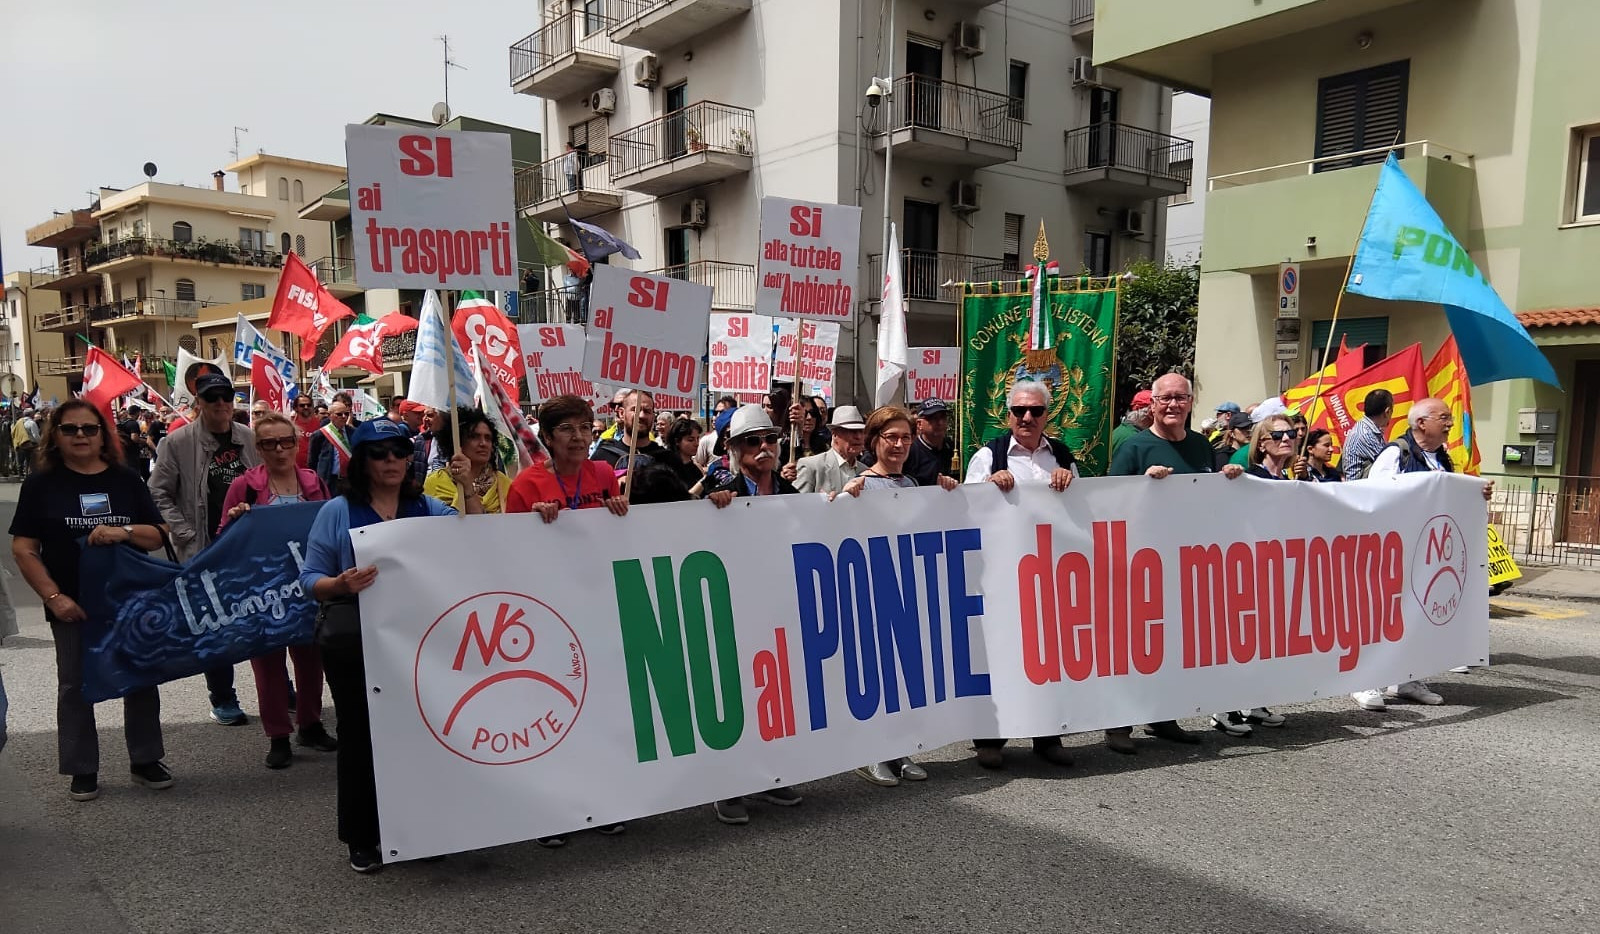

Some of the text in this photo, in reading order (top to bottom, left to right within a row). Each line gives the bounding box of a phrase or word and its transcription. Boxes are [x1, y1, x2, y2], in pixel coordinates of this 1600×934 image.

[400, 135, 452, 177] SI
[358, 183, 382, 211] ai
[366, 218, 512, 283] trasporti
[764, 240, 842, 271] alla tutela
[628, 277, 669, 311] SI
[594, 307, 614, 329] al
[728, 317, 749, 337] SI
[970, 305, 1022, 351] COMUNE
[1050, 302, 1109, 349] OLISTENA
[538, 326, 566, 347] SI
[712, 341, 728, 356] alla
[601, 332, 696, 393] lavoro
[776, 359, 832, 382] publica
[923, 350, 941, 365] SI
[712, 356, 769, 391] sanità
[909, 369, 918, 380] ai
[914, 373, 957, 400] servizi
[1329, 393, 1351, 429] UNIONE
[64, 515, 131, 526] TITENGOSTRETTO
[1431, 593, 1457, 619] PONTE
[613, 520, 1404, 763] NO al PONTE delle menzogne
[471, 710, 563, 754] PONTE
